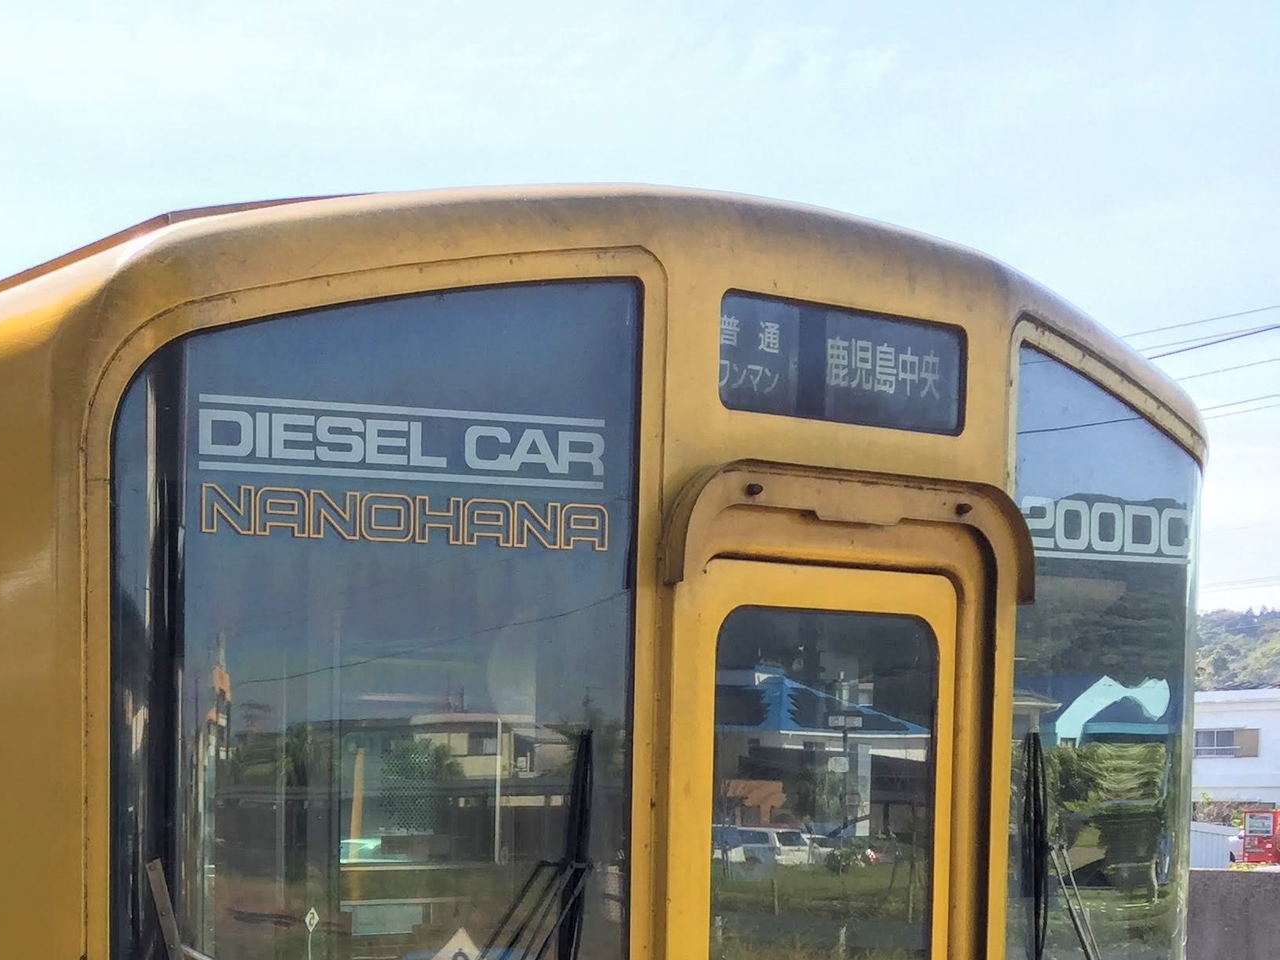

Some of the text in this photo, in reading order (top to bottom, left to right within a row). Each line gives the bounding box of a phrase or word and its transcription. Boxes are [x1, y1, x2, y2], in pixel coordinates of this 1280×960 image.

[826, 335, 941, 401] 鹿児島中央
[198, 408, 606, 476] DIESEL CAR
[201, 482, 609, 551] NANOHANA
[1021, 495, 1191, 556] 200DC
